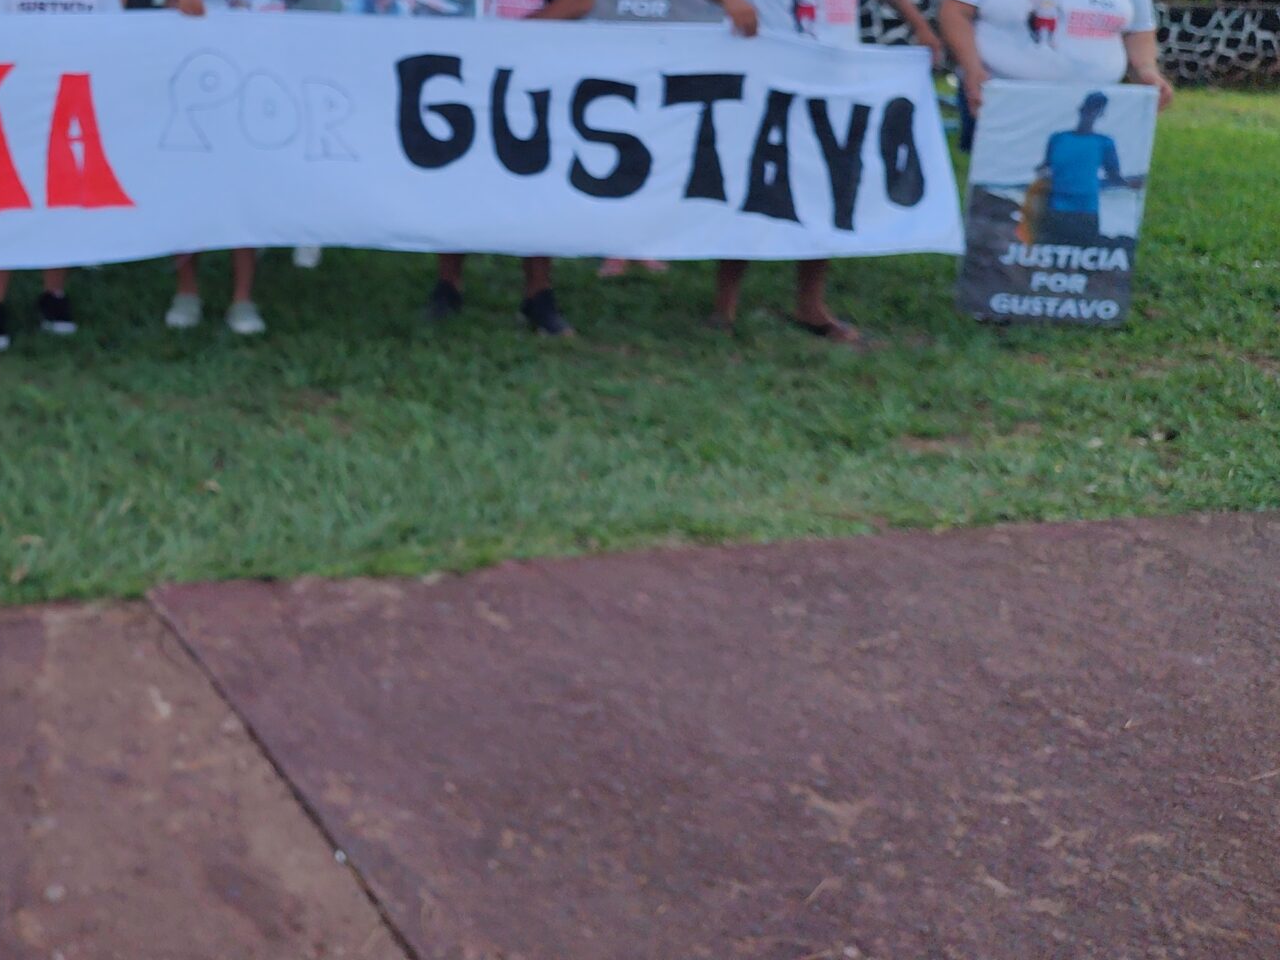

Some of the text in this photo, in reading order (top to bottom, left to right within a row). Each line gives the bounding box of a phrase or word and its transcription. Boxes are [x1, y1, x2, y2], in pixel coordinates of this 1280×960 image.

[395, 53, 926, 232] GUSTAVO
[998, 243, 1130, 272] JUSTICIA
[1030, 272, 1088, 294] POR
[989, 292, 1120, 321] GUSTAVO
